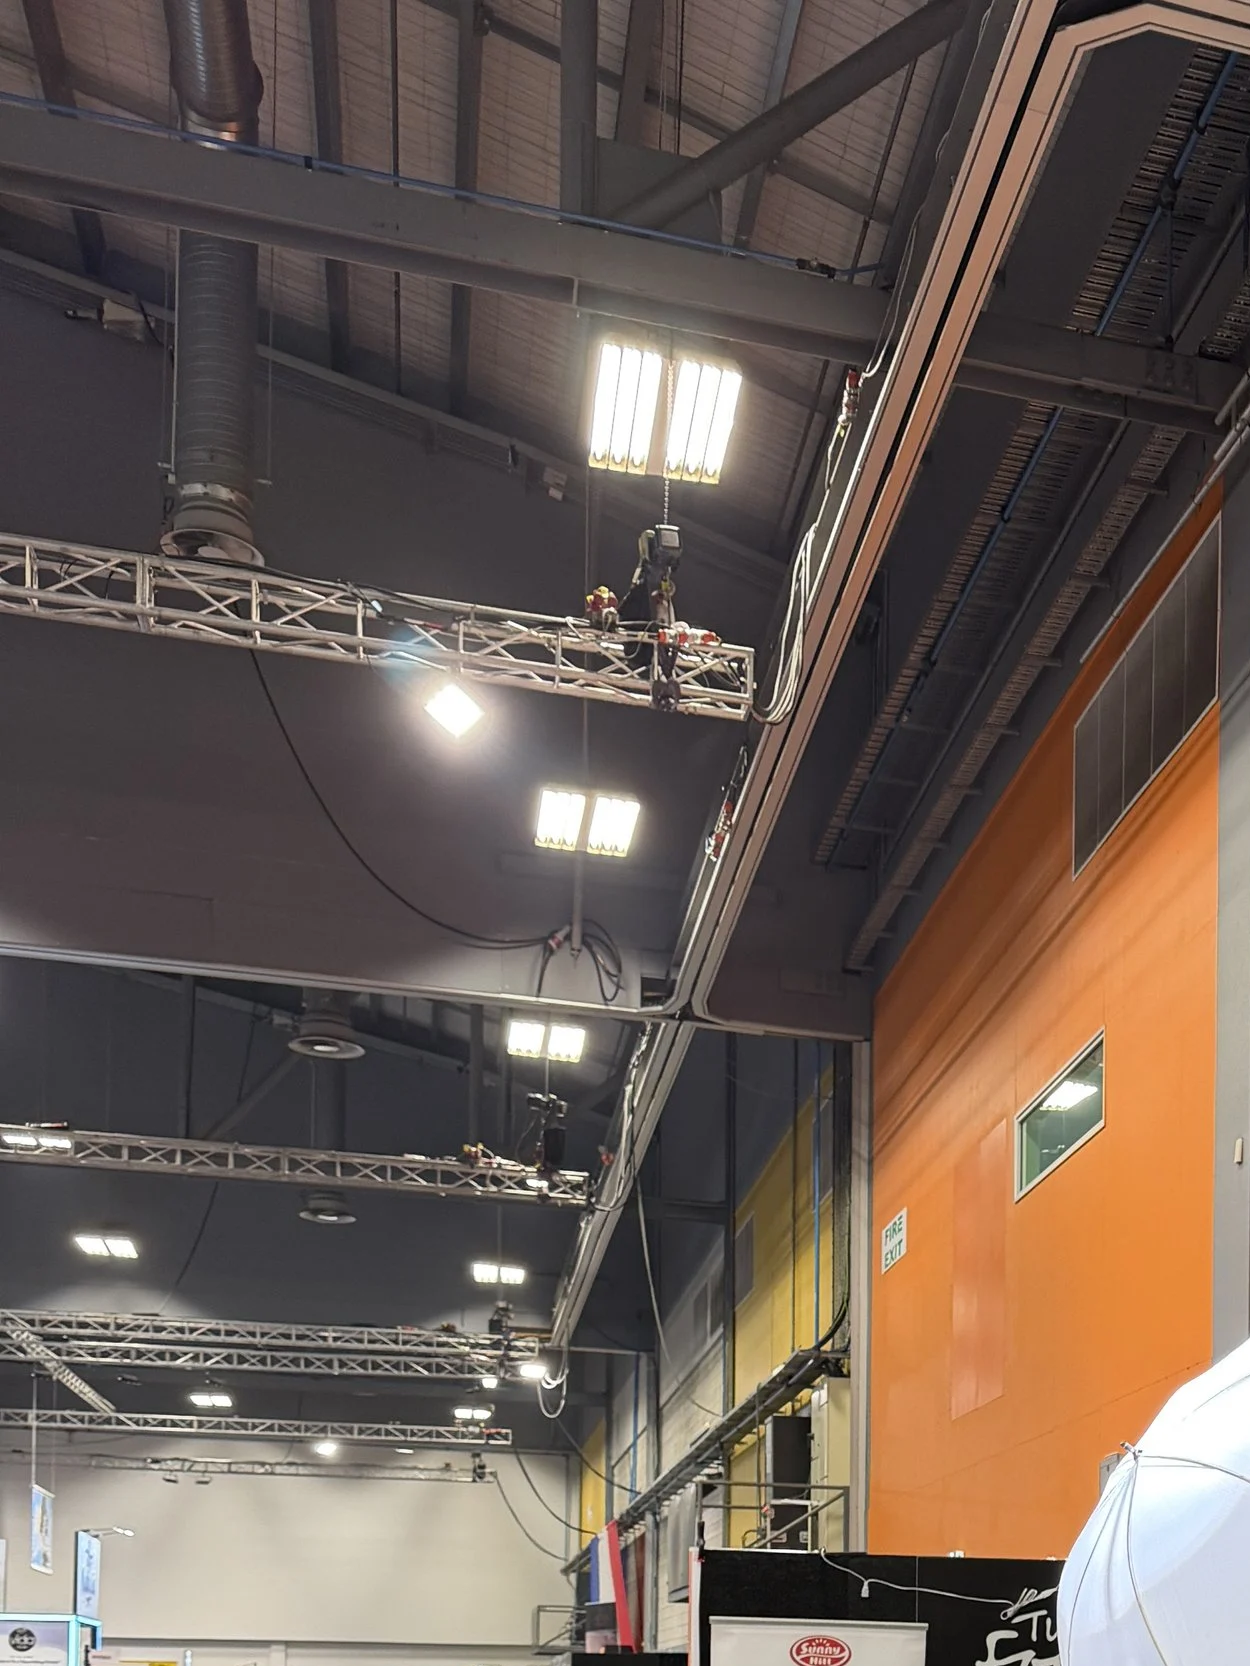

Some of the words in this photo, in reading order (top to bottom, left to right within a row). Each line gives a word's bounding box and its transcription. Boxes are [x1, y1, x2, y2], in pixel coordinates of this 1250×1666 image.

[884, 1214, 903, 1247] FIRE
[884, 1238, 903, 1269] EXIT
[1010, 1609, 1057, 1642] Th
[800, 1642, 841, 1655] Sunny
[809, 1656, 832, 1666] Hill
